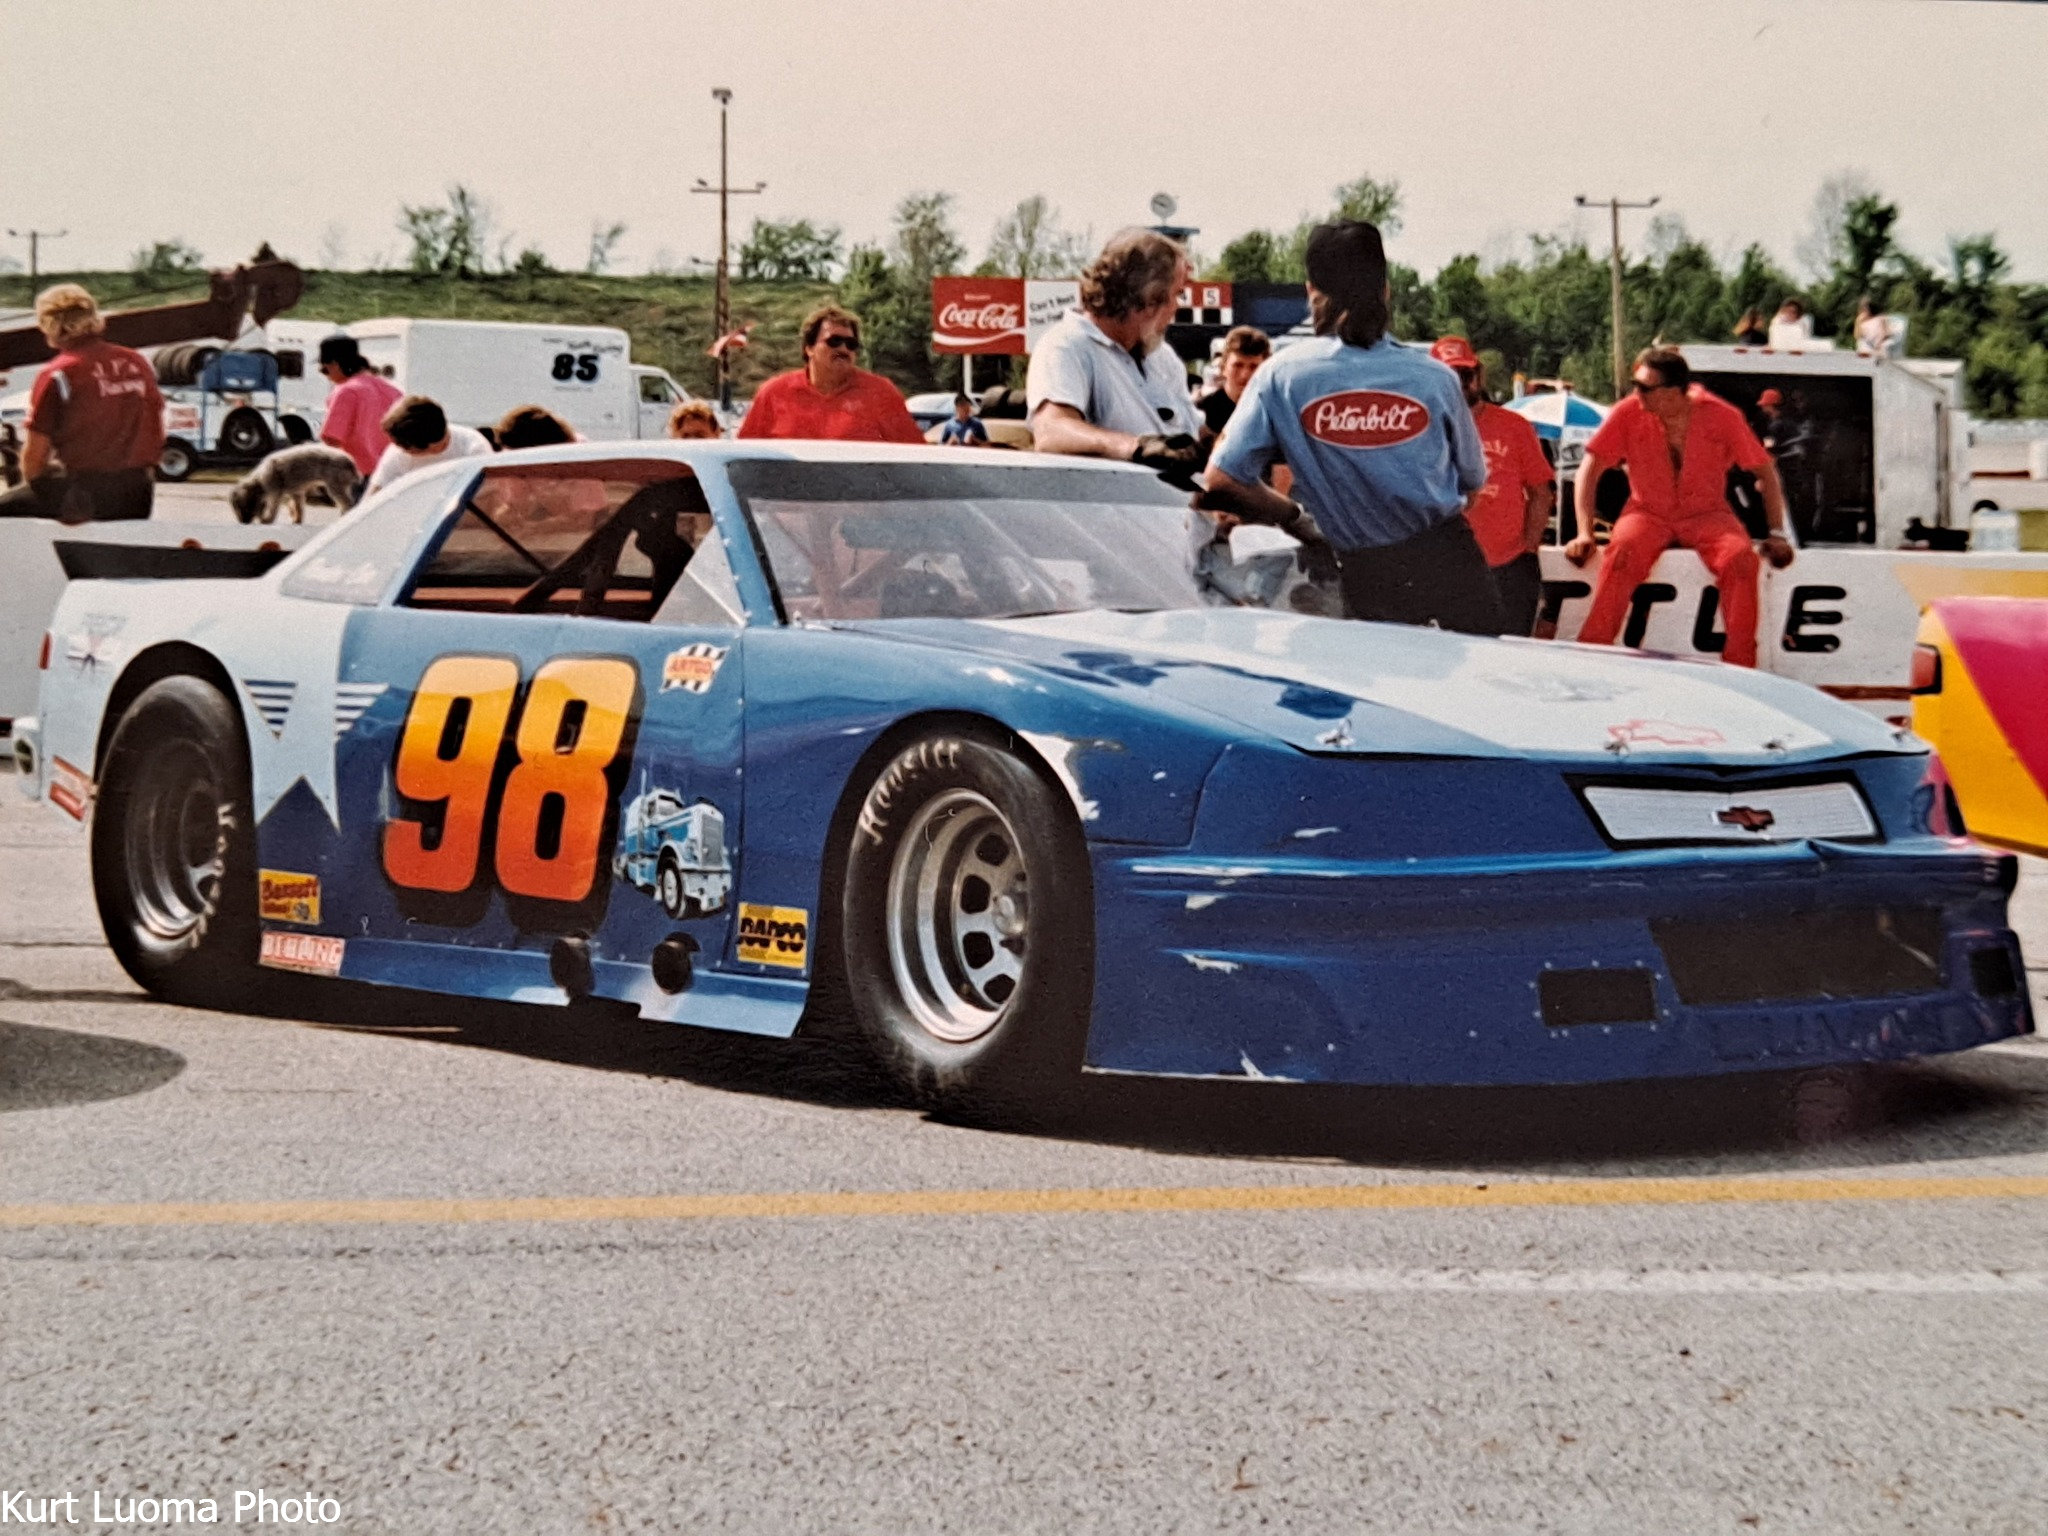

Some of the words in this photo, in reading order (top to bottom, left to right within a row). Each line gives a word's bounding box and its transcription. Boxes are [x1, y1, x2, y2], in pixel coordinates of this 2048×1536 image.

[939, 302, 1019, 329] Coca-Cola
[551, 352, 600, 383] 85
[1315, 401, 1421, 434] Peterbilt
[383, 655, 640, 904] 98
